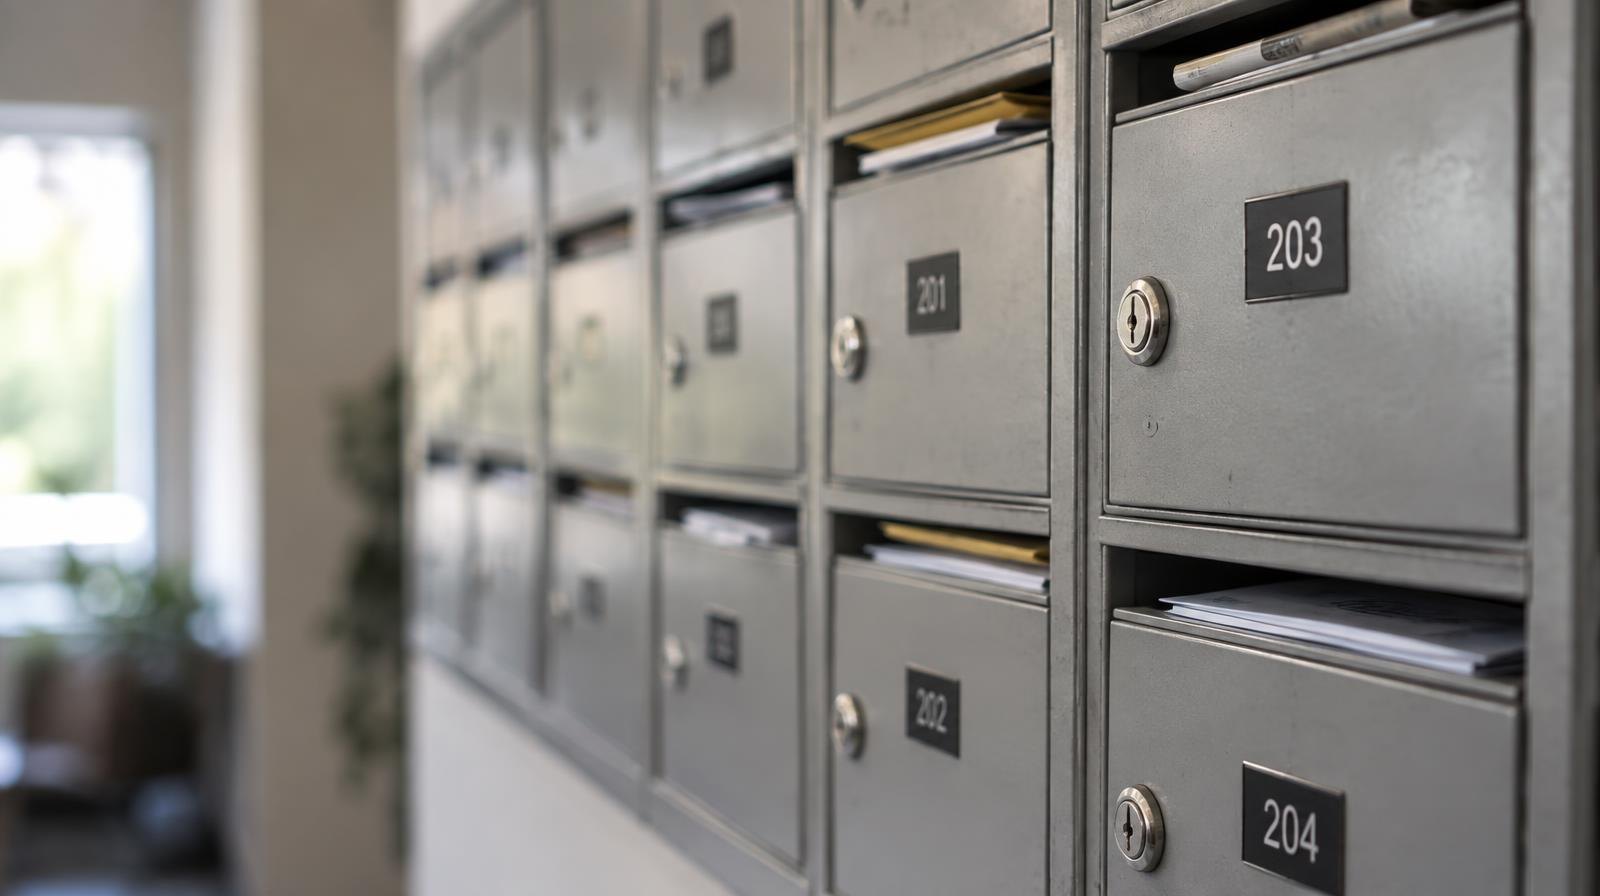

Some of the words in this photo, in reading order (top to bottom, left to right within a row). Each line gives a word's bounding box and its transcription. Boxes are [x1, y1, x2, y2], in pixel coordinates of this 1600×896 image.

[1266, 216, 1323, 272] 203
[916, 274, 946, 315] 201
[916, 687, 948, 734] 202
[1263, 798, 1319, 864] 204
